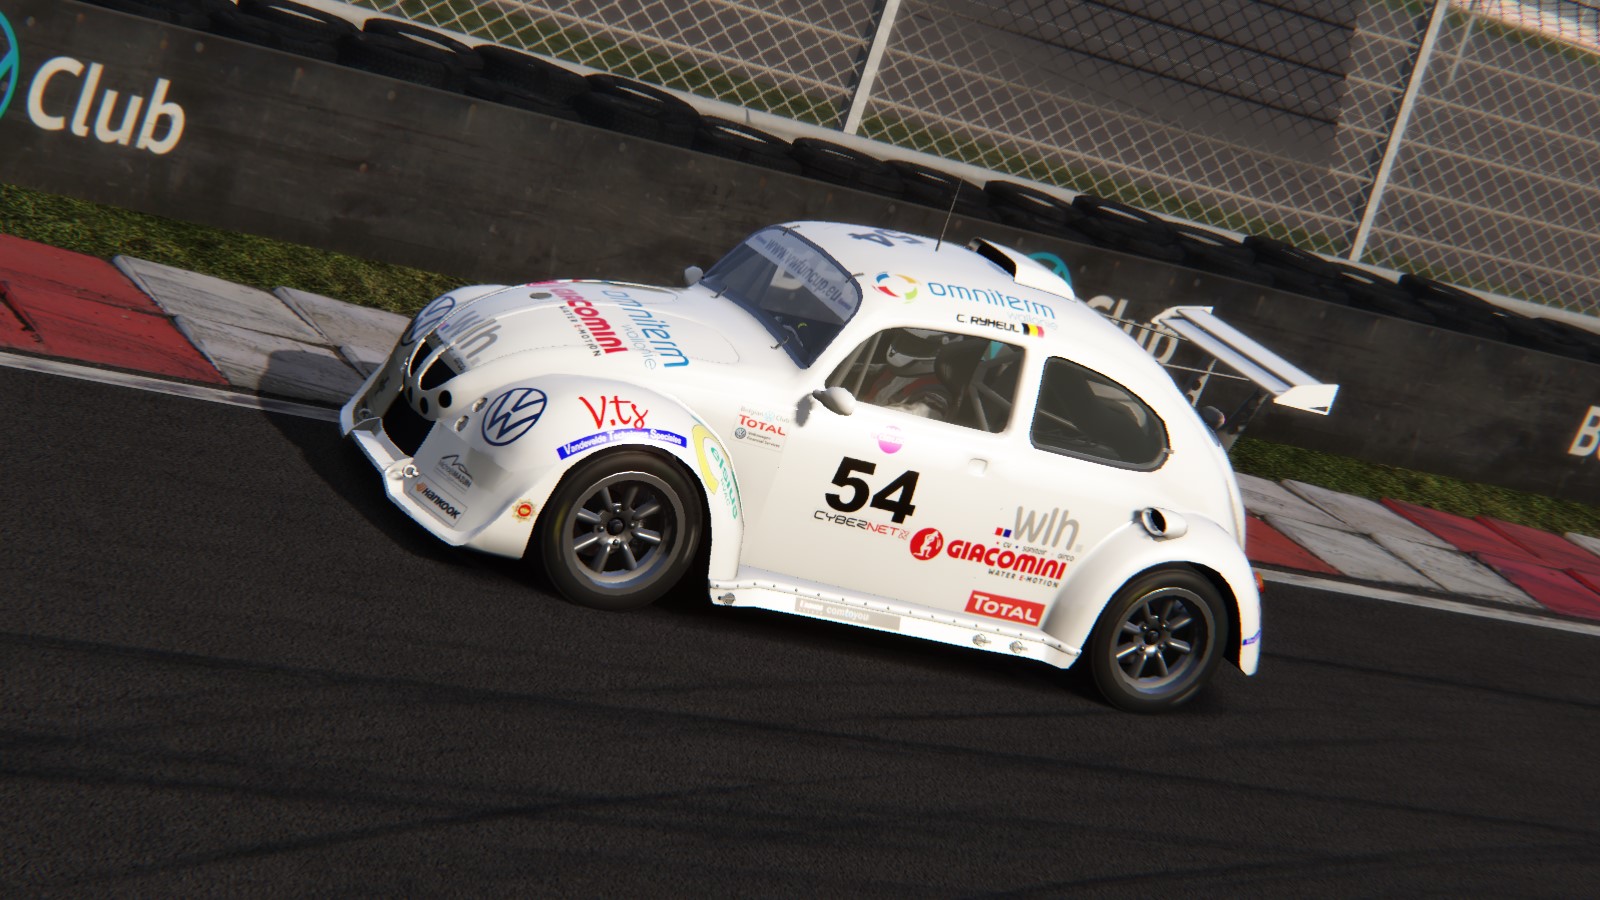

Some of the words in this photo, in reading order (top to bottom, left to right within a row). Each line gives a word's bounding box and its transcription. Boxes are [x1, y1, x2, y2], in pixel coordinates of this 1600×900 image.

[27, 56, 186, 155] Club
[927, 282, 1056, 320] omniterm
[602, 290, 689, 368] omniterm
[739, 414, 786, 436] TOTAL
[825, 456, 920, 524] 54
[947, 539, 1067, 580] GIACOMINI
[988, 568, 1016, 581] WATER
[1018, 575, 1060, 588] E-MOTION
[973, 593, 1038, 623] TOTAL
